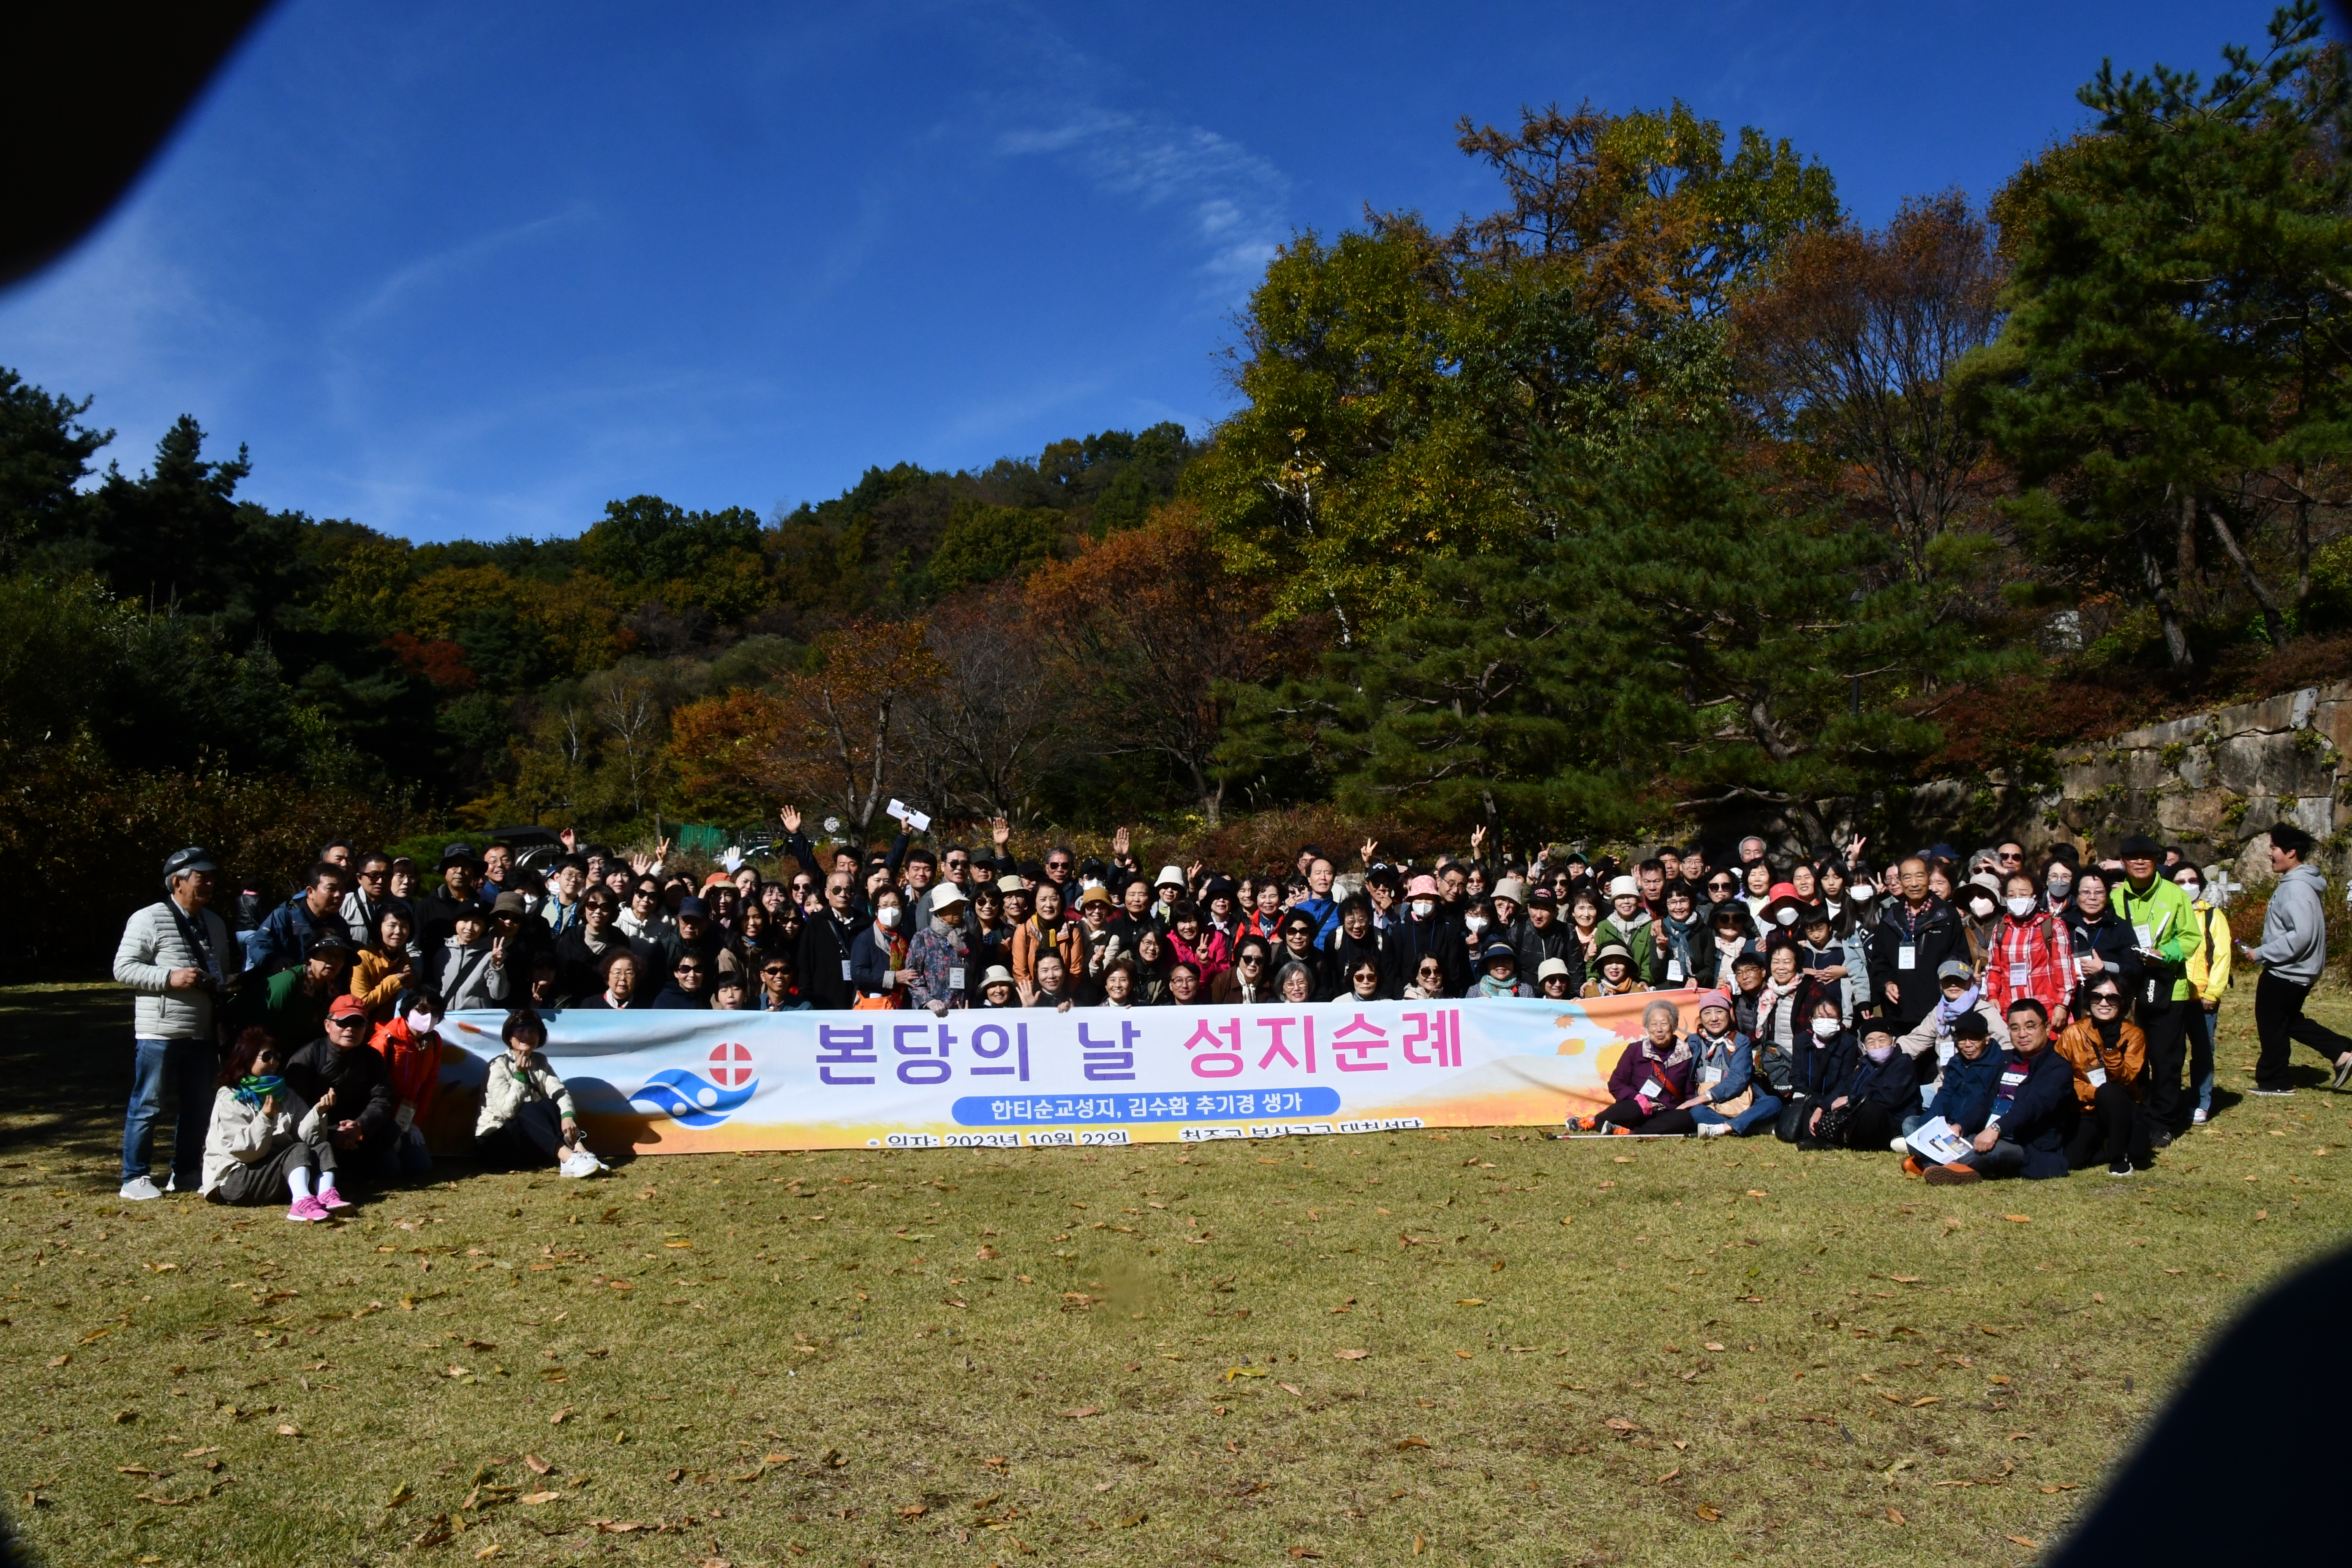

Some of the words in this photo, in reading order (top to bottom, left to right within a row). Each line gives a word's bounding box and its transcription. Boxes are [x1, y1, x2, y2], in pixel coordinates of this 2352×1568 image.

[2147, 979, 2156, 1003] adidas
[816, 1022, 1030, 1085] 본당의
[1078, 1020, 1141, 1081] 날
[1182, 1009, 1462, 1078] 성지순례
[991, 1098, 1122, 1120] 한티순교성지,
[1128, 1096, 1190, 1117] 김수환
[1195, 1094, 1255, 1115] 추기경
[1261, 1092, 1303, 1113] 생가
[947, 1134, 1019, 1146] 2023년
[1029, 1132, 1073, 1144] 10월
[1082, 1132, 1127, 1144] 22일
